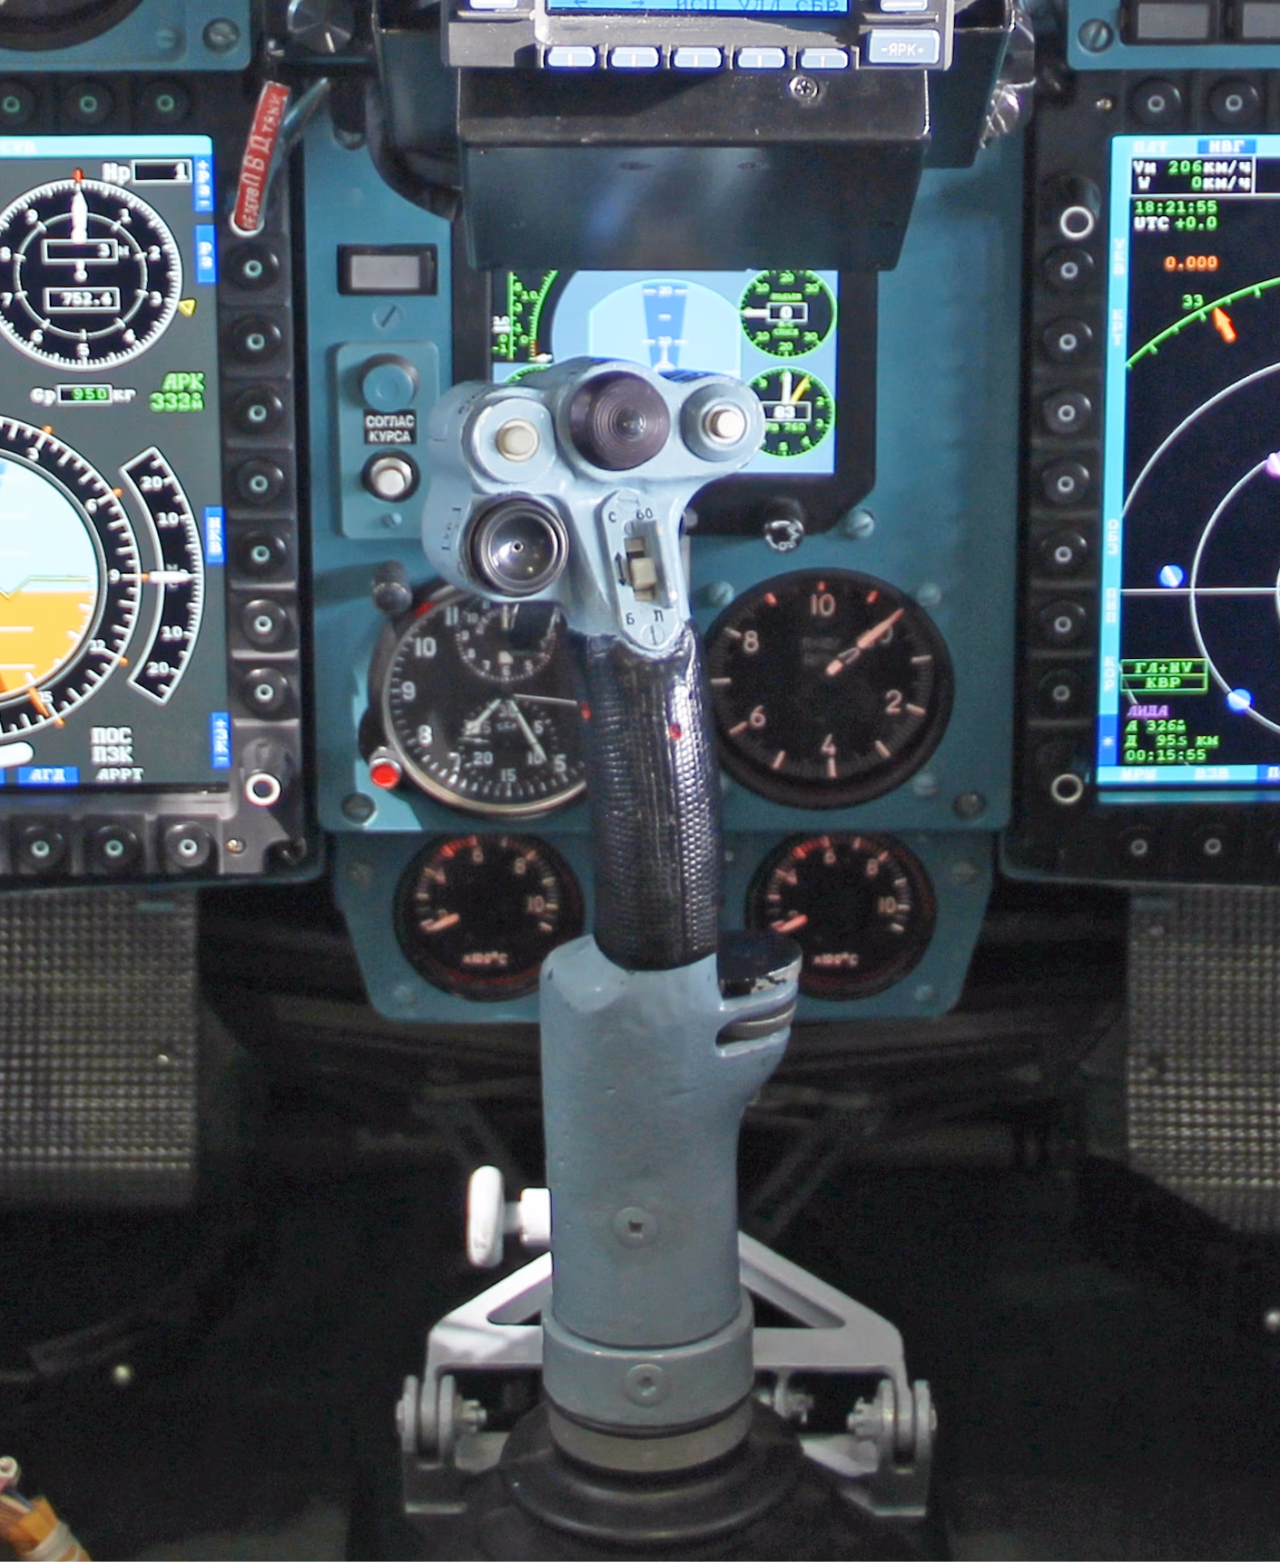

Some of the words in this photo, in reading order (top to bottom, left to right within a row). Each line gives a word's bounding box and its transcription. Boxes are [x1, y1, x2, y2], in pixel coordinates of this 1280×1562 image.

[1208, 140, 1245, 153] НВГ
[1134, 200, 1218, 214] 18:21:55
[1133, 216, 1170, 231] UTC
[1173, 217, 1218, 231] +0.0
[1163, 255, 1220, 272] 0.000
[61, 291, 112, 307] 752.4
[1181, 294, 1204, 309] 33
[162, 372, 205, 392] АРК
[72, 387, 108, 401] 950
[365, 414, 415, 428] СОГЛАС
[368, 429, 413, 444] КУРСА
[141, 476, 162, 490] 20
[810, 593, 836, 617] 10
[445, 606, 459, 626] 11
[414, 638, 437, 658] 10
[743, 630, 760, 654] 8
[147, 663, 169, 677] 20
[401, 681, 416, 700] 9
[1145, 676, 1181, 689] КВР
[885, 689, 903, 714] 2
[749, 705, 766, 728] 6
[1126, 704, 1169, 718] ЛИДА
[90, 727, 133, 745] ПОС
[821, 734, 837, 756] 4
[473, 751, 493, 765] 20
[1124, 749, 1208, 763] 00:15:55
[527, 896, 545, 913] 10
[879, 898, 897, 914] 10
